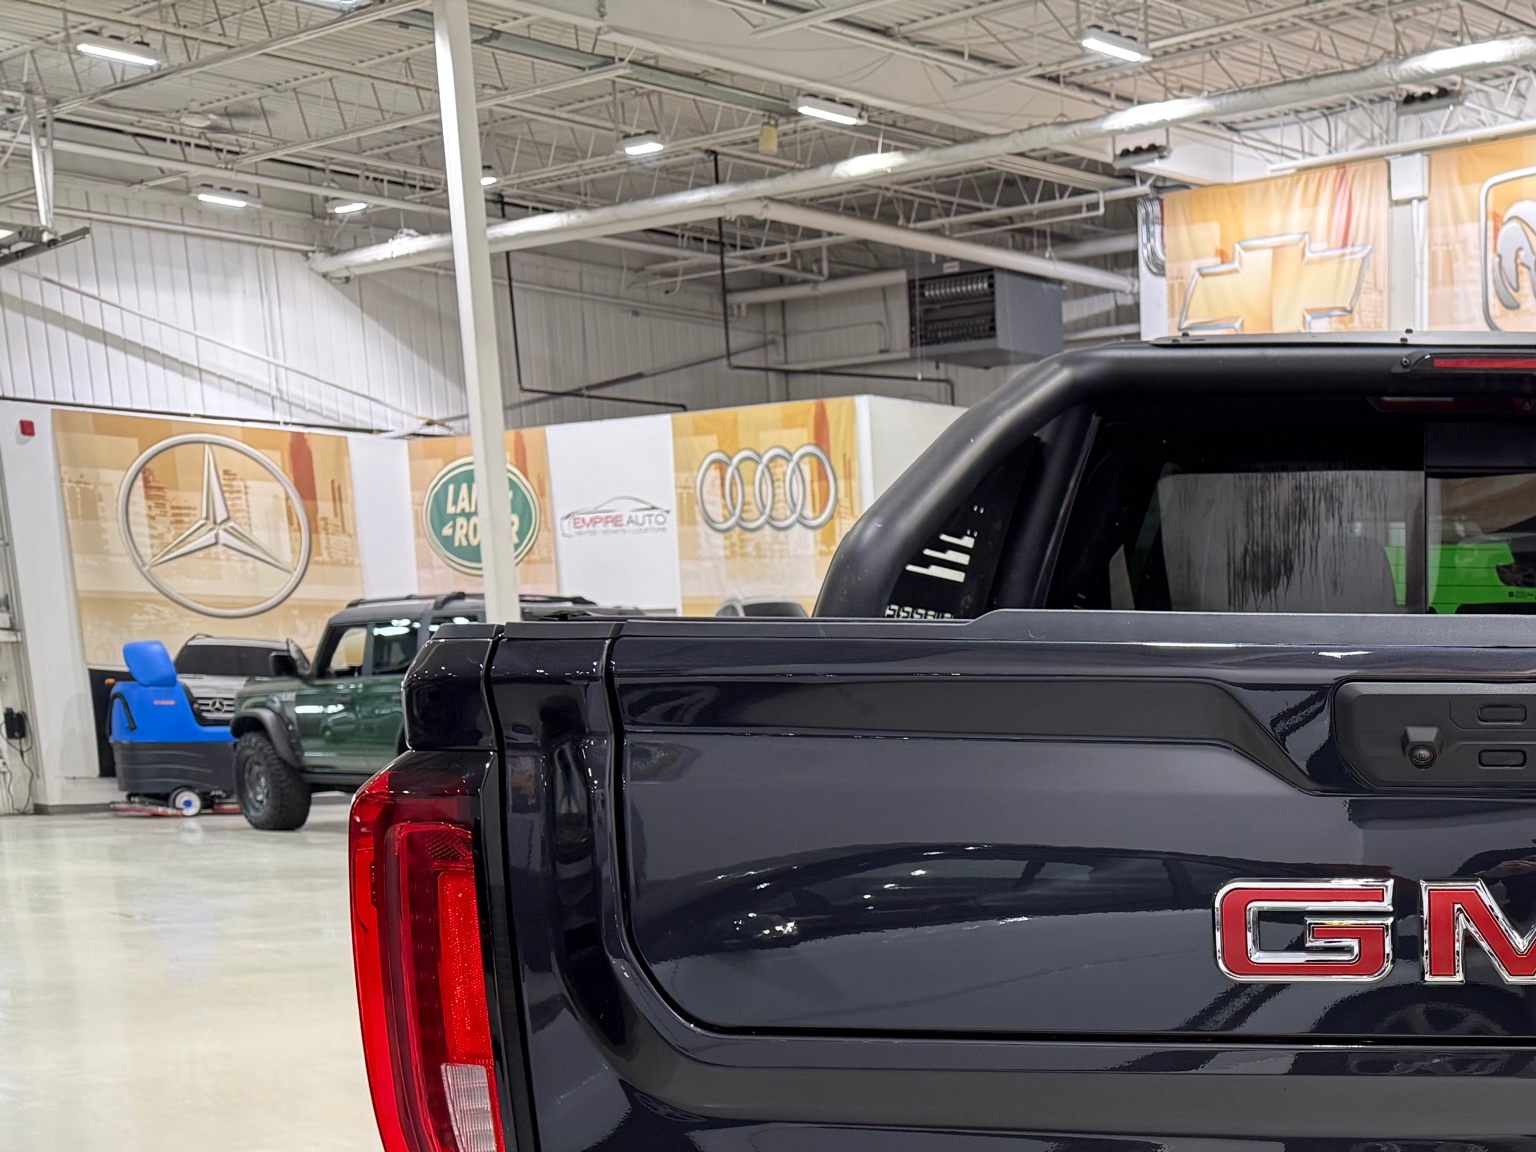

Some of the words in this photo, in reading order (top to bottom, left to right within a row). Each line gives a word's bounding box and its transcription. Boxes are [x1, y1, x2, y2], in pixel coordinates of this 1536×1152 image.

[453, 512, 520, 547] ROR
[572, 514, 624, 529] EMPIRE
[626, 512, 667, 527] AUTO
